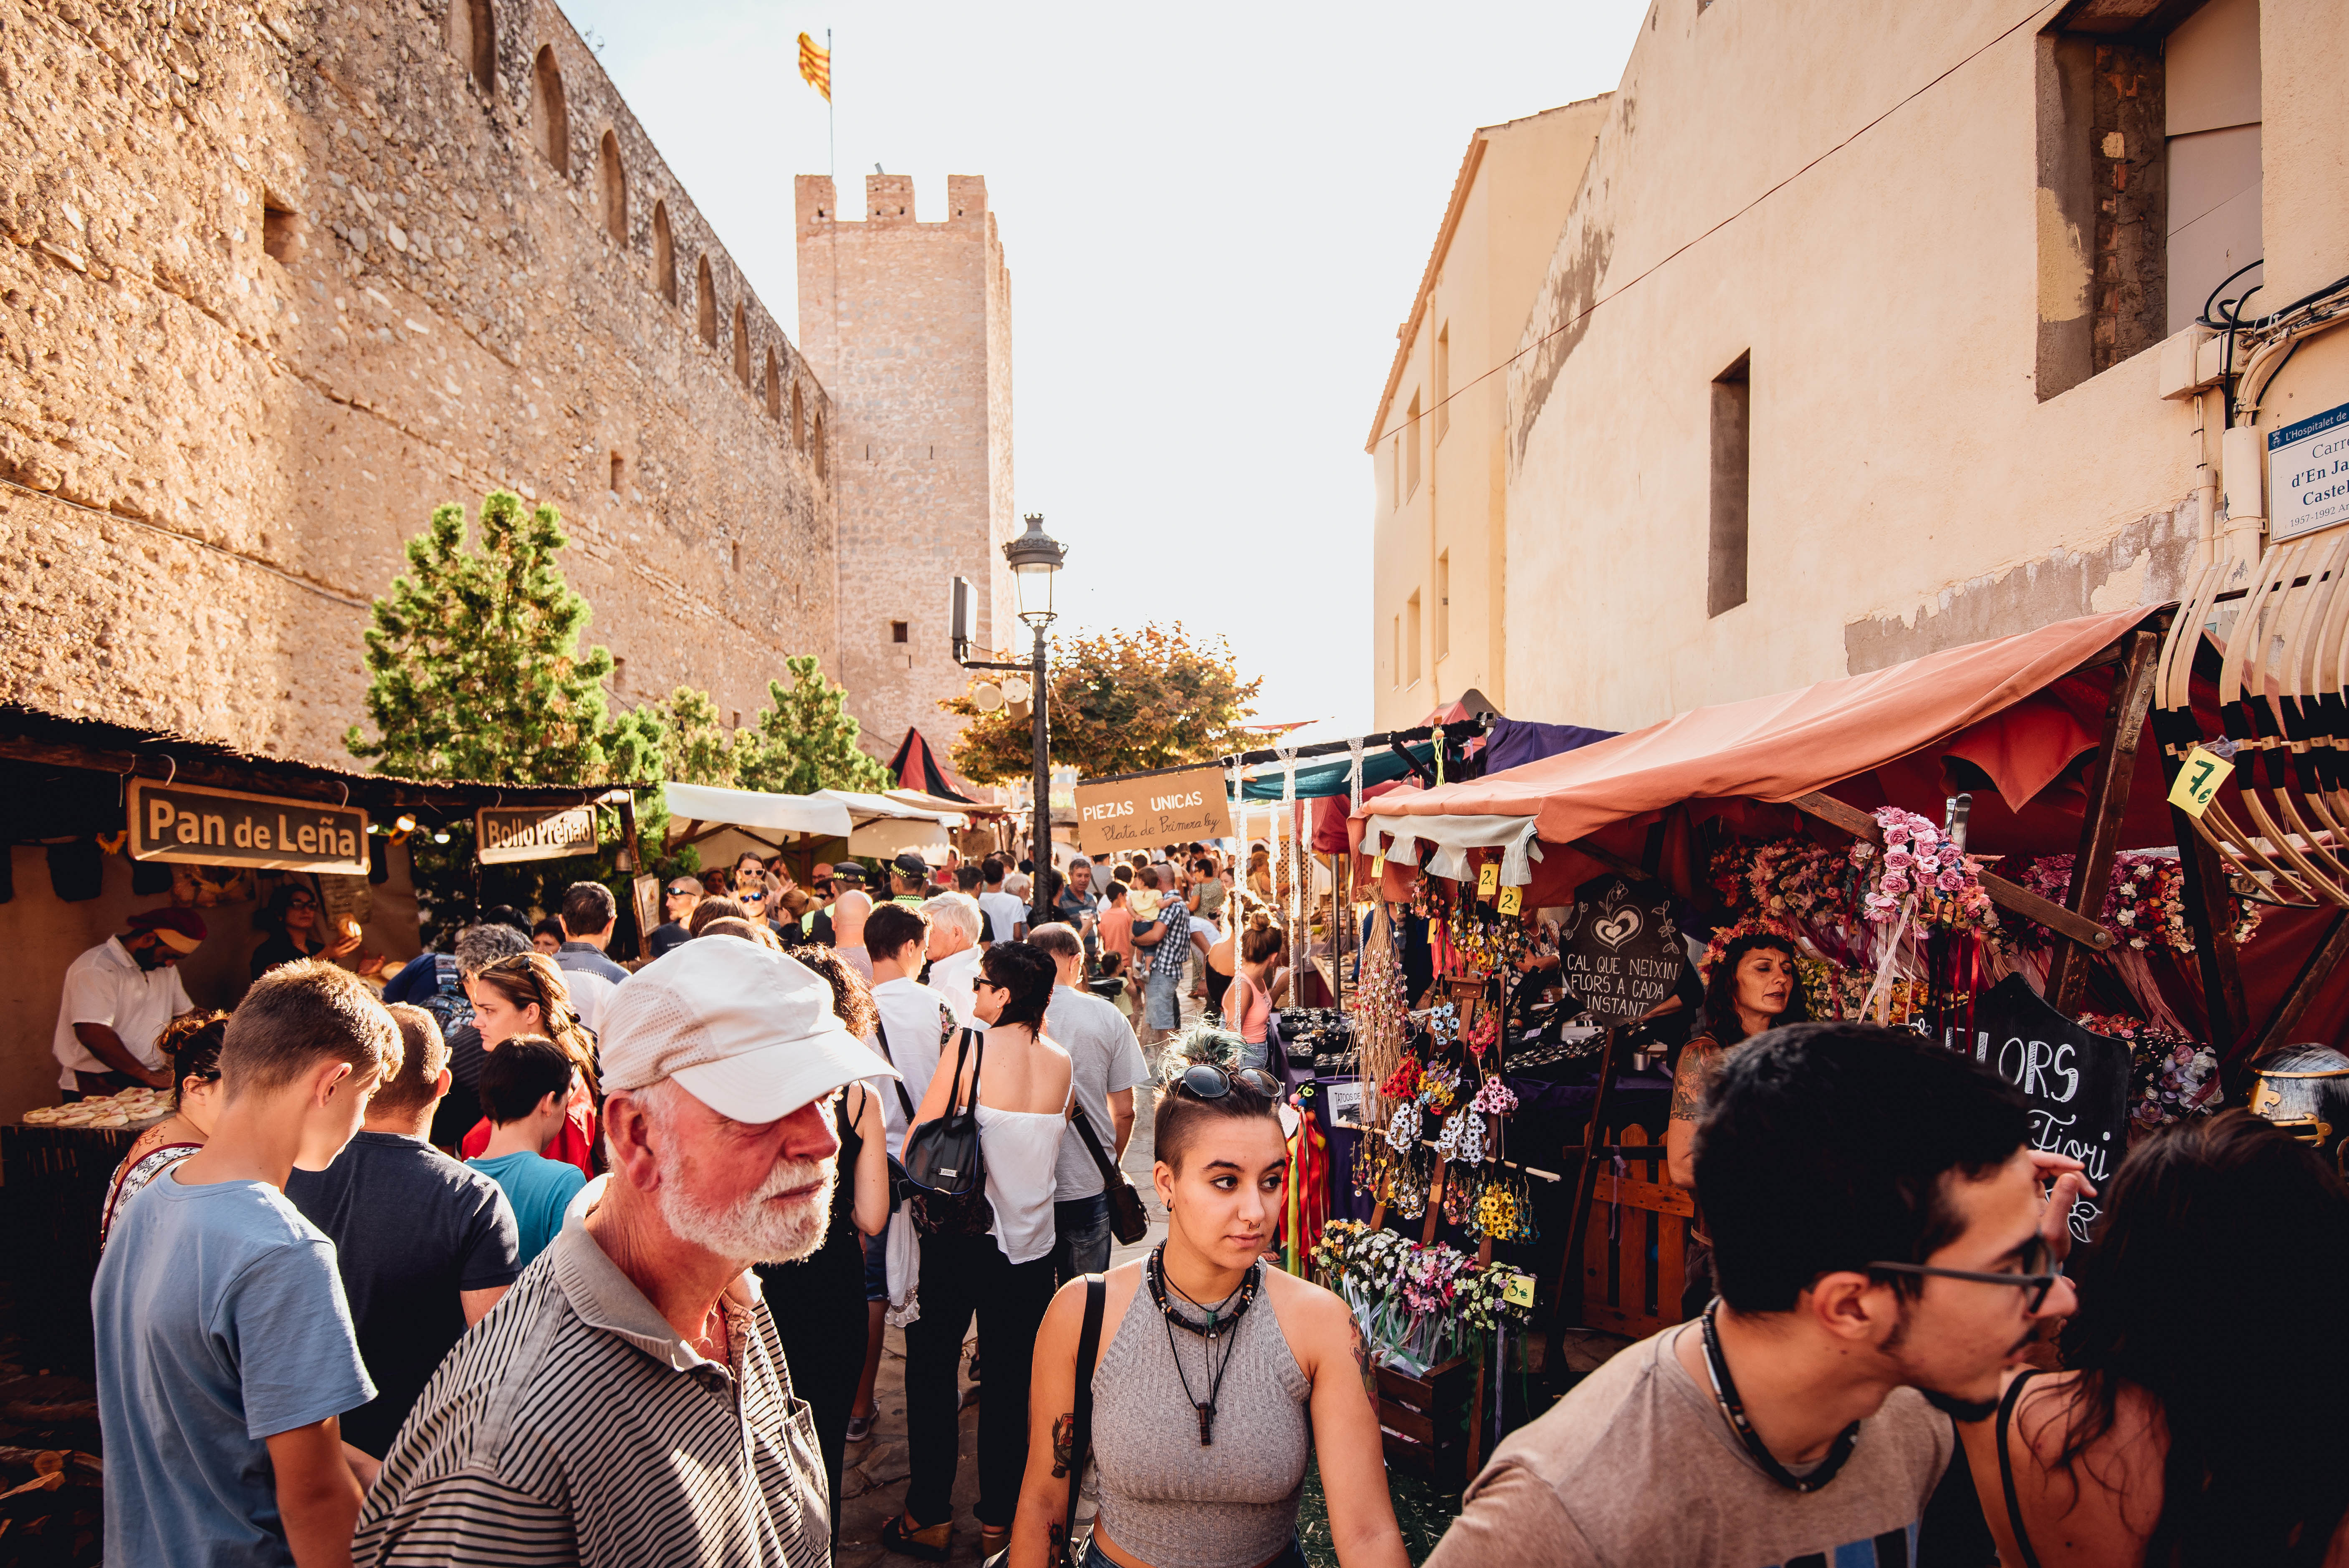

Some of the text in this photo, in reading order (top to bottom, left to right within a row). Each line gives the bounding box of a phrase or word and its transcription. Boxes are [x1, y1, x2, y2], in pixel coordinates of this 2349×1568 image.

[2286, 412, 2346, 441] L'Hospitalet de
[2292, 468, 2326, 488] d'En
[2291, 506, 2335, 527] 1957-1992
[1083, 791, 1203, 822] PIEZAS UNICAS
[149, 799, 356, 857] Pan de Leña
[488, 818, 535, 848] Bollo
[1102, 824, 1138, 841] Plata
[1140, 818, 1155, 835] de
[1159, 816, 1202, 833] Primera
[1568, 954, 1590, 971] CAL
[1597, 956, 1620, 975] QUE
[1571, 974, 1664, 1000] FLORS A CADA
[1587, 994, 1649, 1017] INSTANT
[1335, 1092, 1353, 1105] TATOOS
